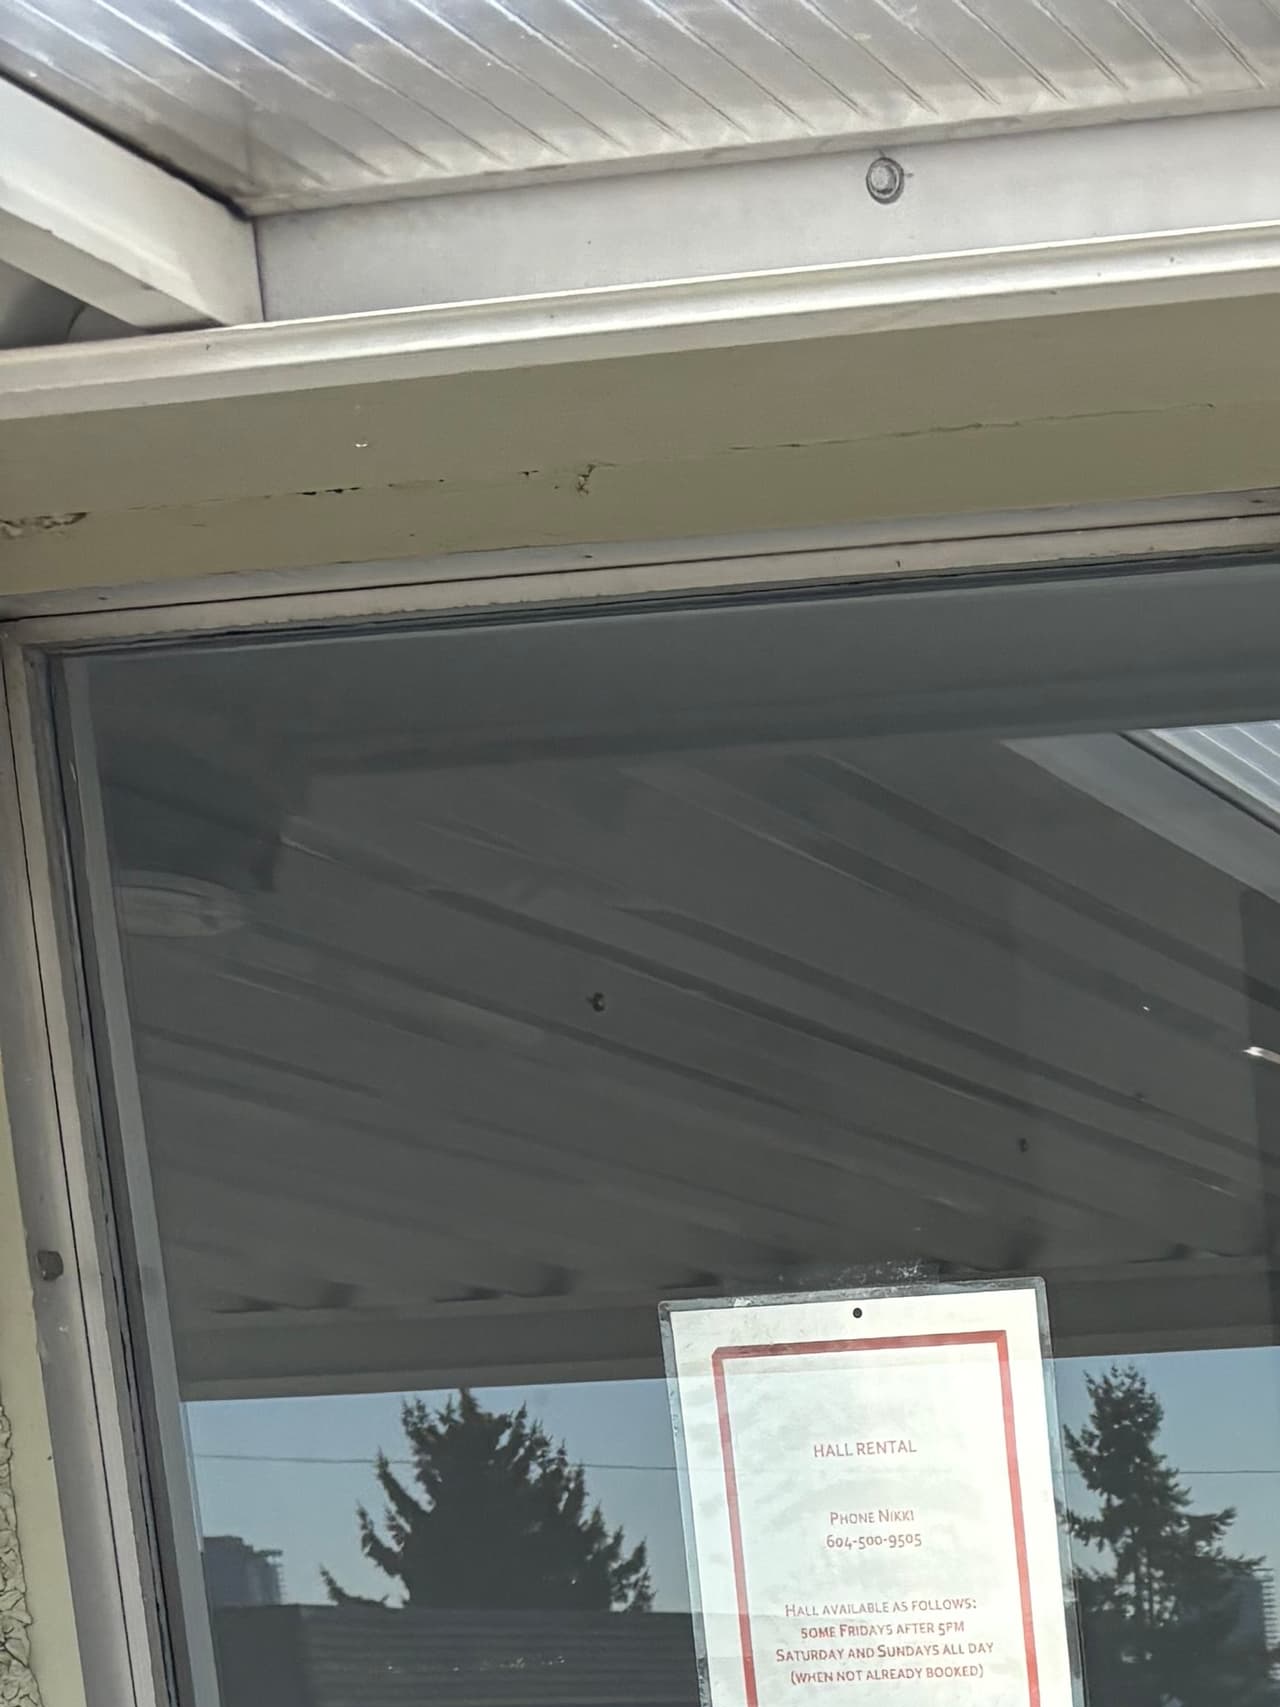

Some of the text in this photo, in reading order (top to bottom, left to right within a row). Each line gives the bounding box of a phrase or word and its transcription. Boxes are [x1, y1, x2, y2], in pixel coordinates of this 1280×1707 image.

[813, 1439, 917, 1458] HALL RENTAL
[826, 1533, 922, 1551] 604-500-9505
[785, 1597, 977, 1617] HALL AVAILABLE AS FOLLOWS:
[801, 1620, 965, 1640] SOME FRIDAYS AFTER 5PM
[775, 1641, 994, 1662] SATURDAY AND SUNDAYS ALL DAY
[790, 1663, 984, 1685] (WHEN NOT ALREADY BOOKED)
